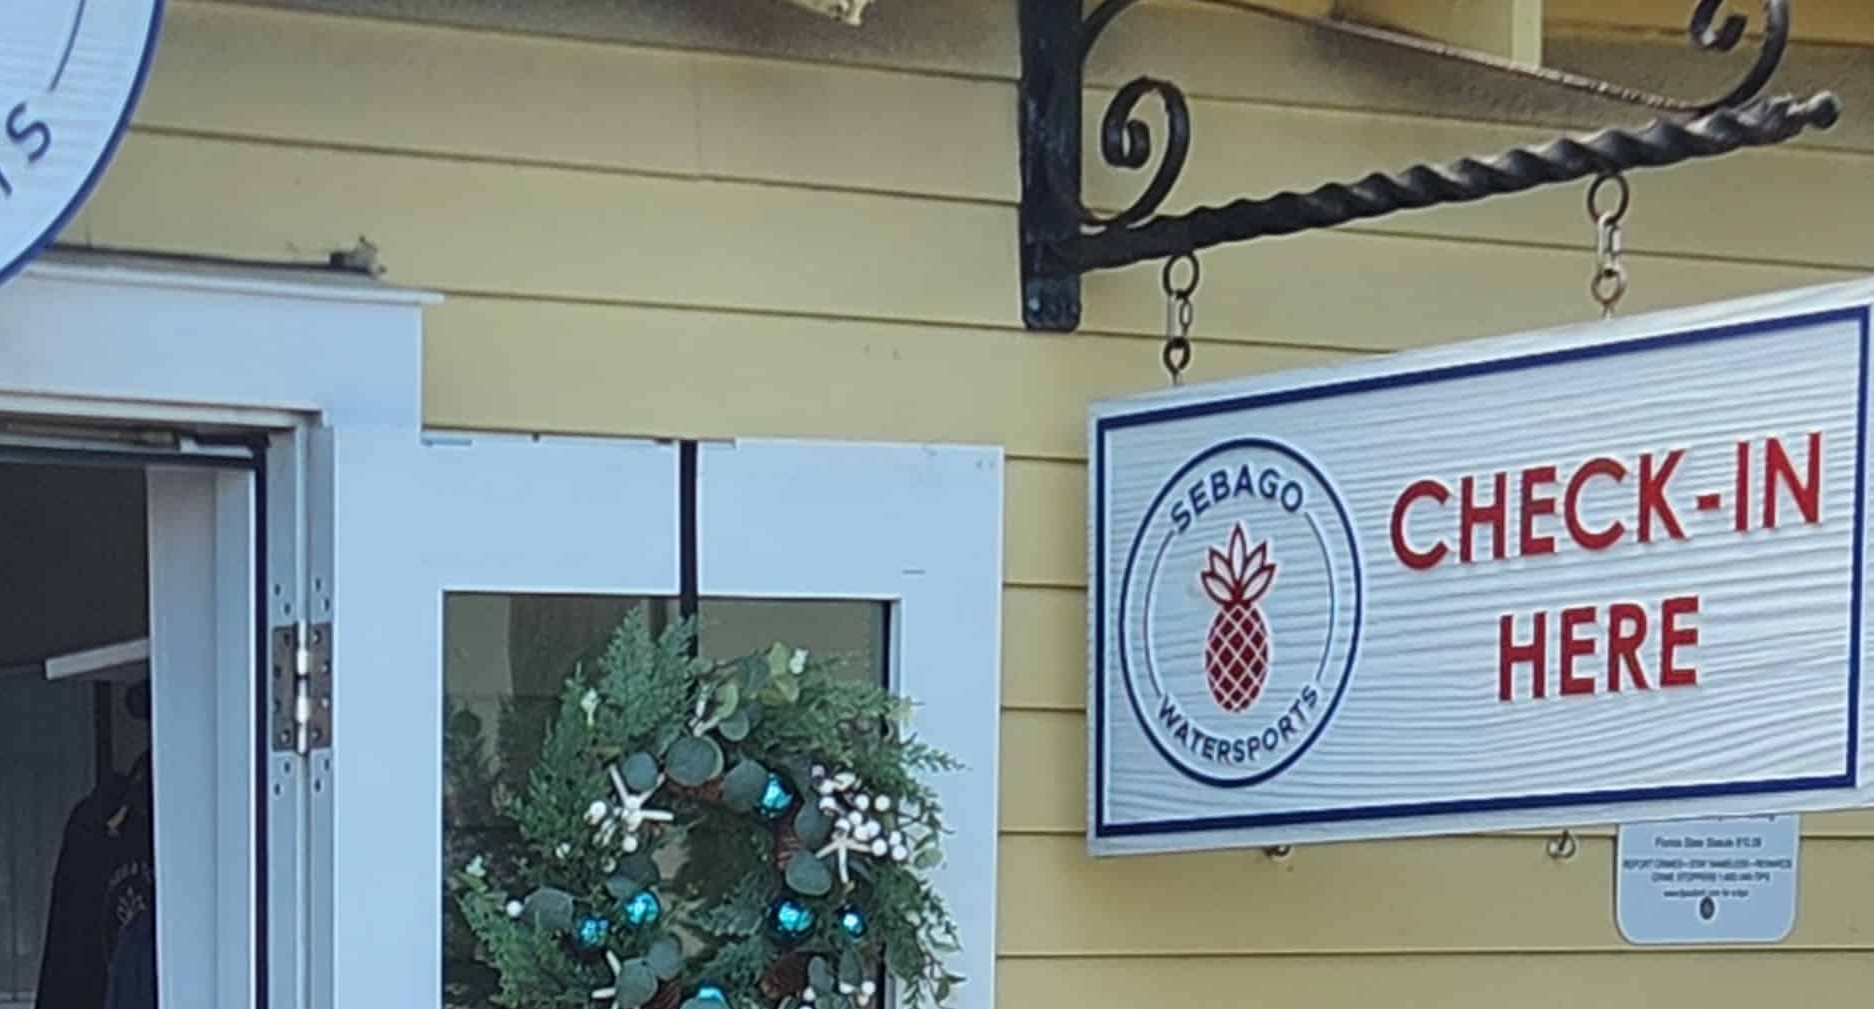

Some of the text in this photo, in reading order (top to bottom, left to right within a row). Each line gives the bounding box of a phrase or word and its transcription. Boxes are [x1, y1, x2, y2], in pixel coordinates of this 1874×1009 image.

[1169, 462, 1306, 536] SEBAGO
[1390, 432, 1823, 570] CHECK-IN
[1499, 597, 1700, 702] HERE
[1157, 684, 1321, 764] WATERSPORTS
